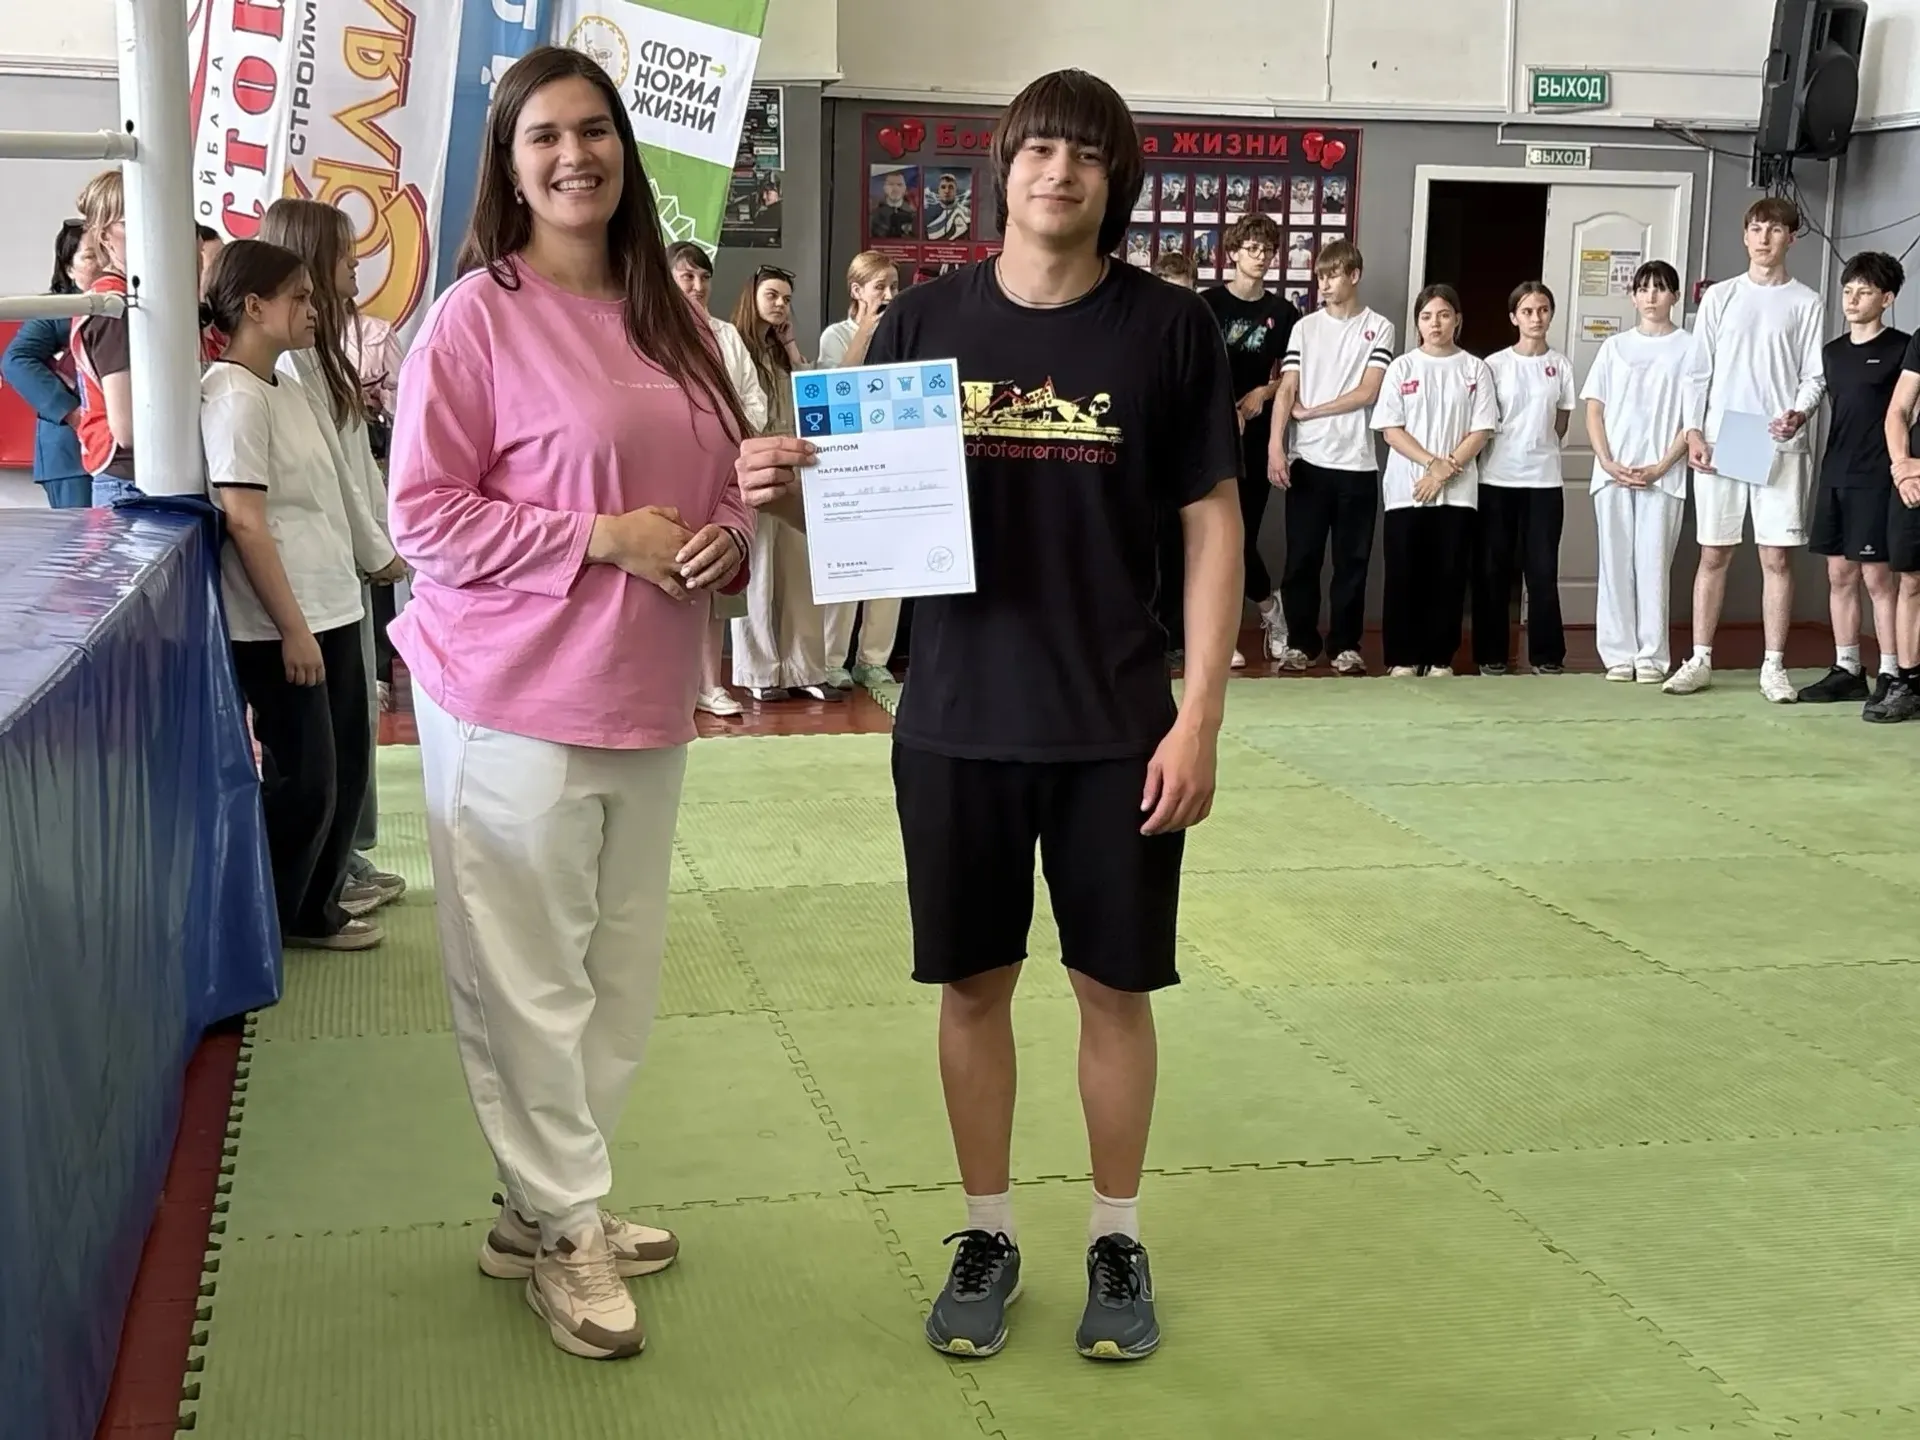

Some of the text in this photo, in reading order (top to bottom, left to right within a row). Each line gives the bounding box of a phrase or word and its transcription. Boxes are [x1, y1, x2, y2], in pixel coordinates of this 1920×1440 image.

[640, 40, 712, 77] СПОРТ
[634, 64, 721, 108] НОРМА
[1537, 77, 1601, 101] ВЫХОД
[630, 89, 716, 134] ЖИЗНИ
[200, 56, 224, 216] ОЙБАЗА
[936, 124, 993, 149] Бок
[1172, 132, 1288, 156] ЖИЗНИ
[1532, 150, 1583, 166] ВЫХОД
[816, 444, 859, 454] ДИПЛОМ
[964, 441, 1117, 464] onoterremotato
[818, 464, 886, 475] НАГРАЖДАЕТСЯ
